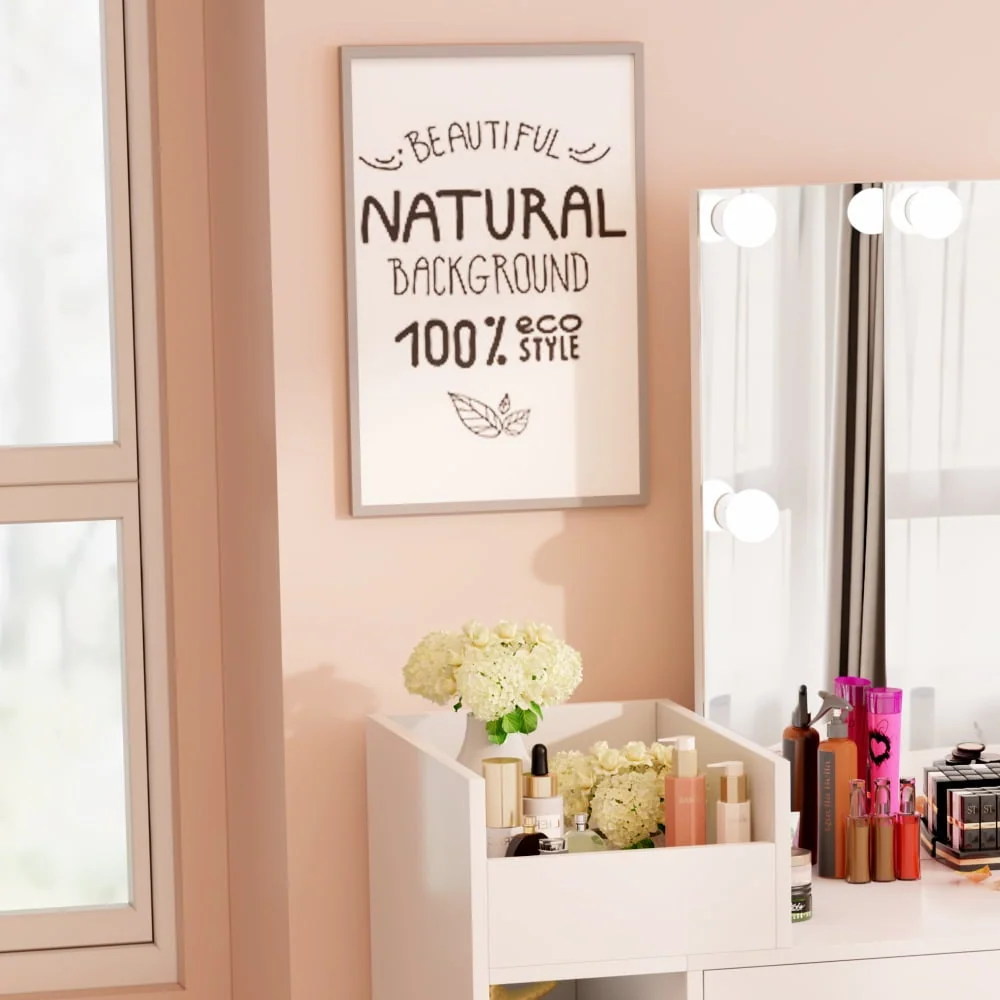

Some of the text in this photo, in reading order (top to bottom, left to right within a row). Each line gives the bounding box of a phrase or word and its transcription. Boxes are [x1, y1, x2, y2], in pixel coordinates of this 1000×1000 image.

[404, 120, 559, 163] BEAUTIFUL
[361, 185, 627, 243] NATURAL
[387, 252, 588, 296] BACKGROUND
[395, 316, 507, 368] 100%
[519, 336, 580, 362] STYLE
